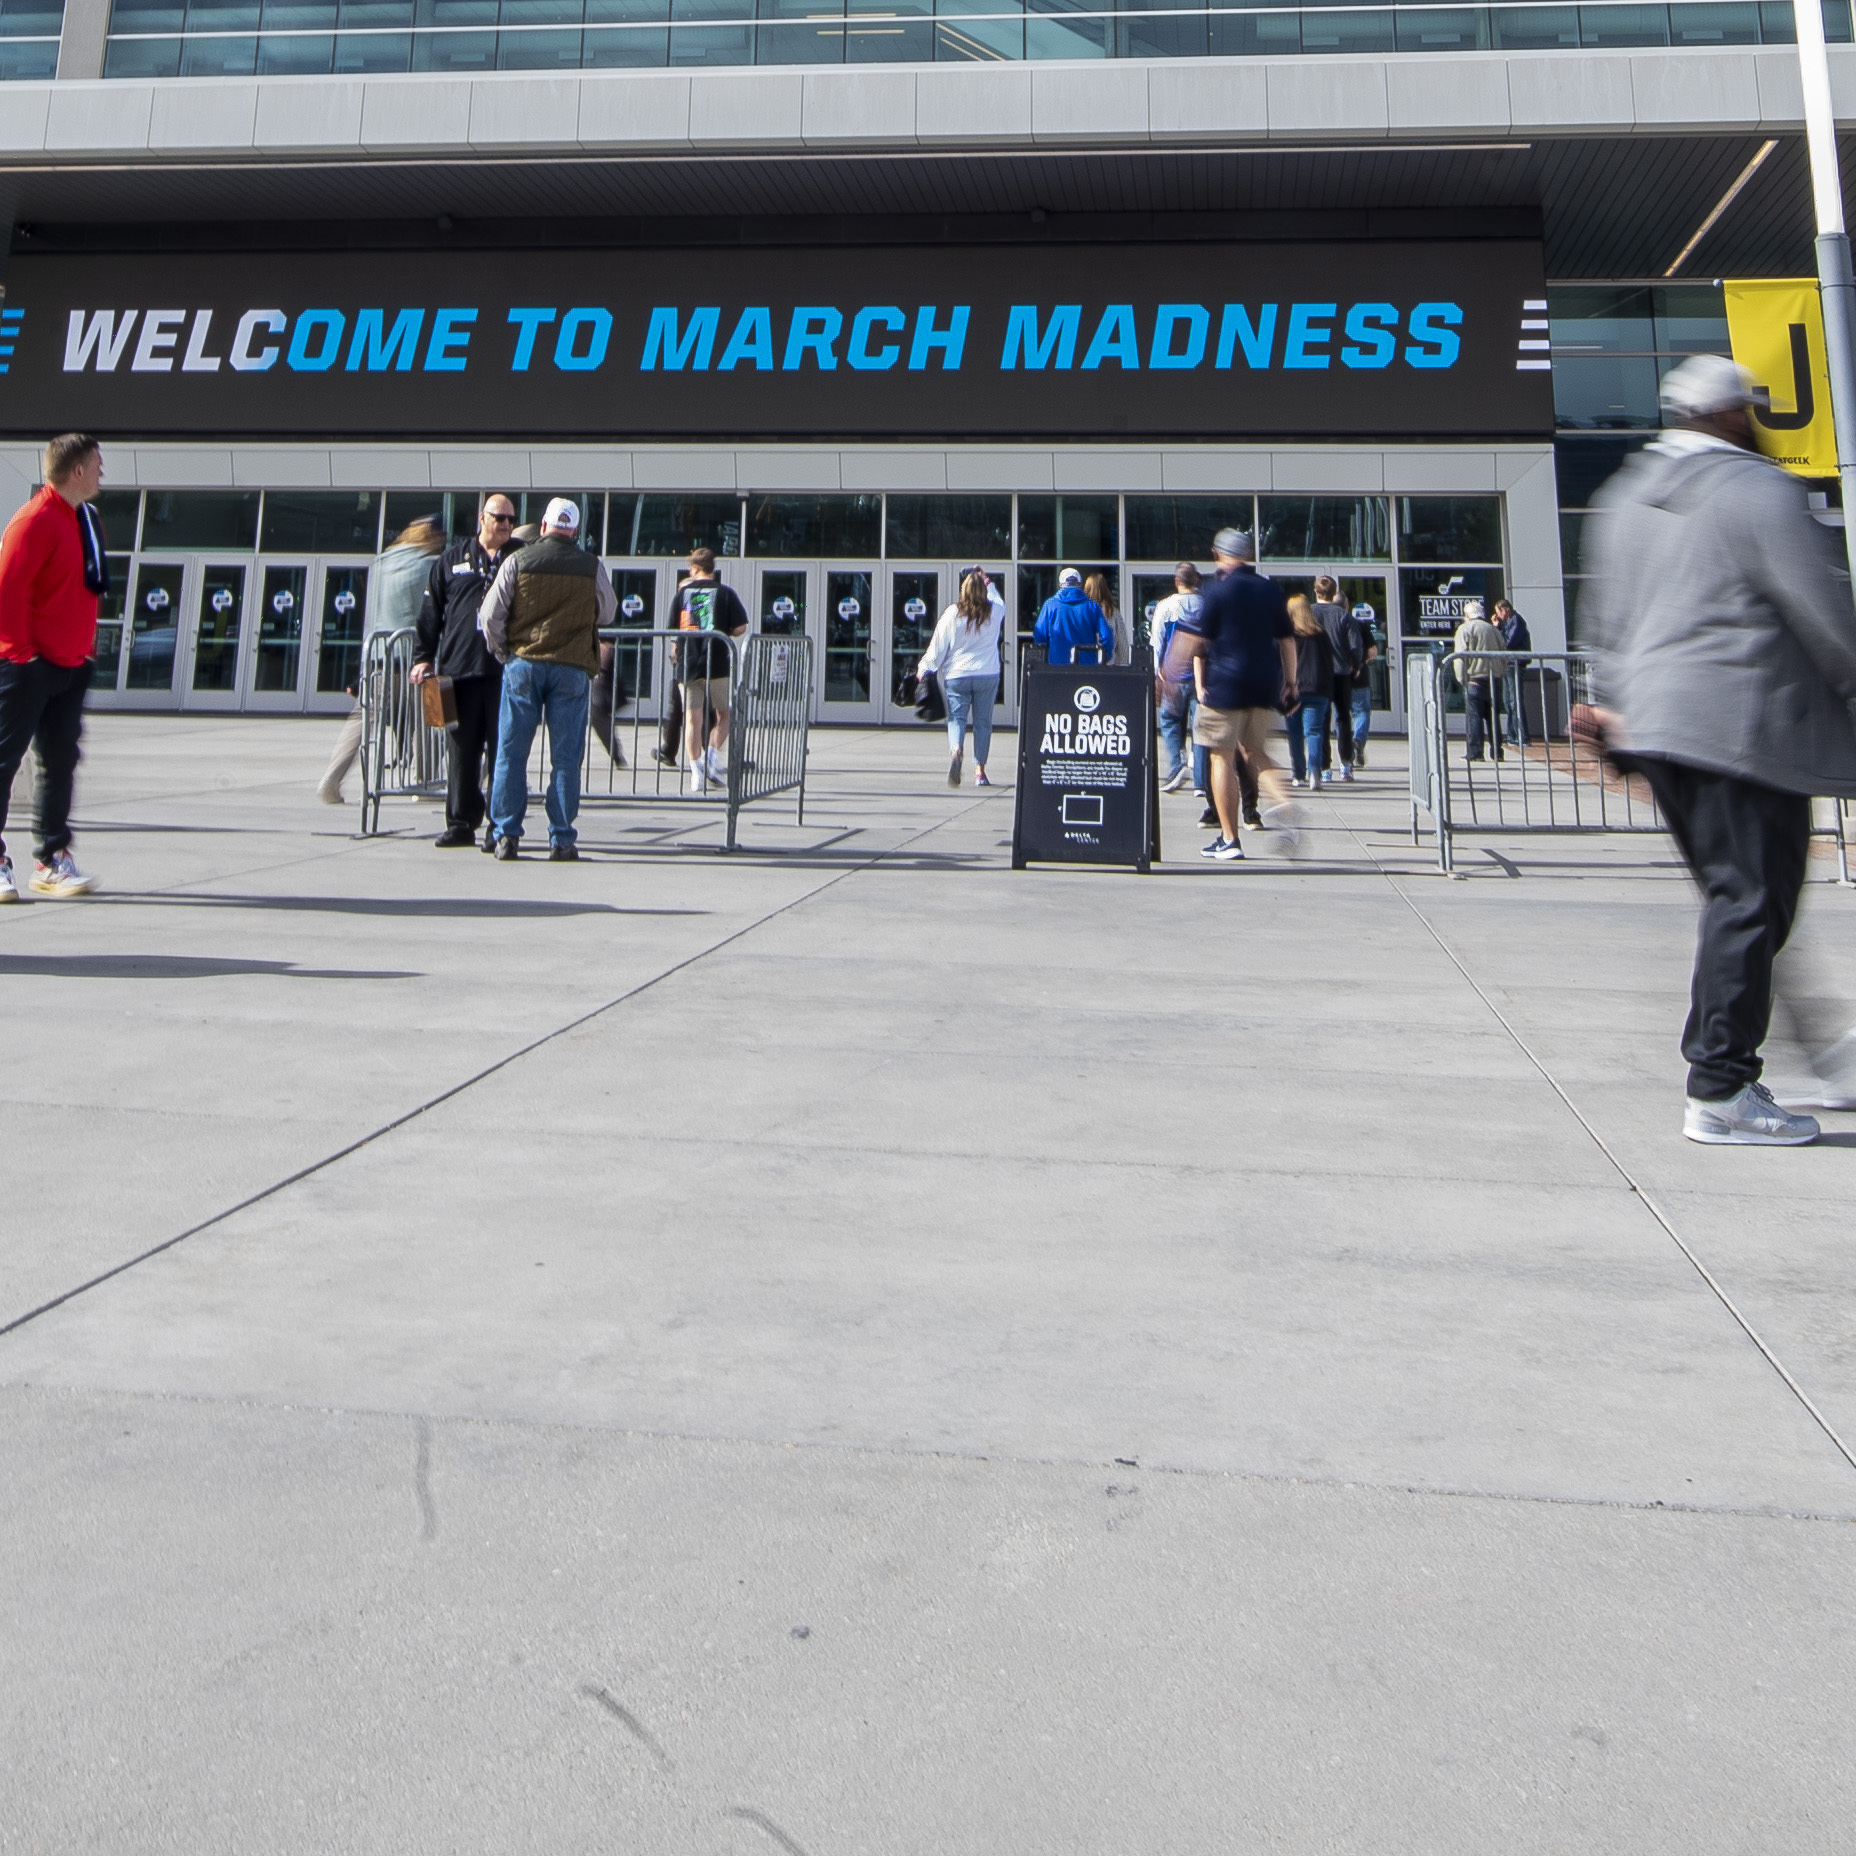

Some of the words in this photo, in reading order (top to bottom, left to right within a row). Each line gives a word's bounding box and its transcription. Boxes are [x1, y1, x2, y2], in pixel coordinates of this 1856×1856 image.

[62, 308, 478, 372] WELCOME
[508, 308, 613, 372] TO
[640, 306, 971, 372] MARCH
[1000, 302, 1464, 371] MADNESS
[1751, 322, 1815, 431] J
[1420, 598, 1450, 616] TEAM
[1045, 713, 1072, 735] NO
[1077, 713, 1128, 736] BAGS
[1039, 733, 1131, 756] ALLOWED
